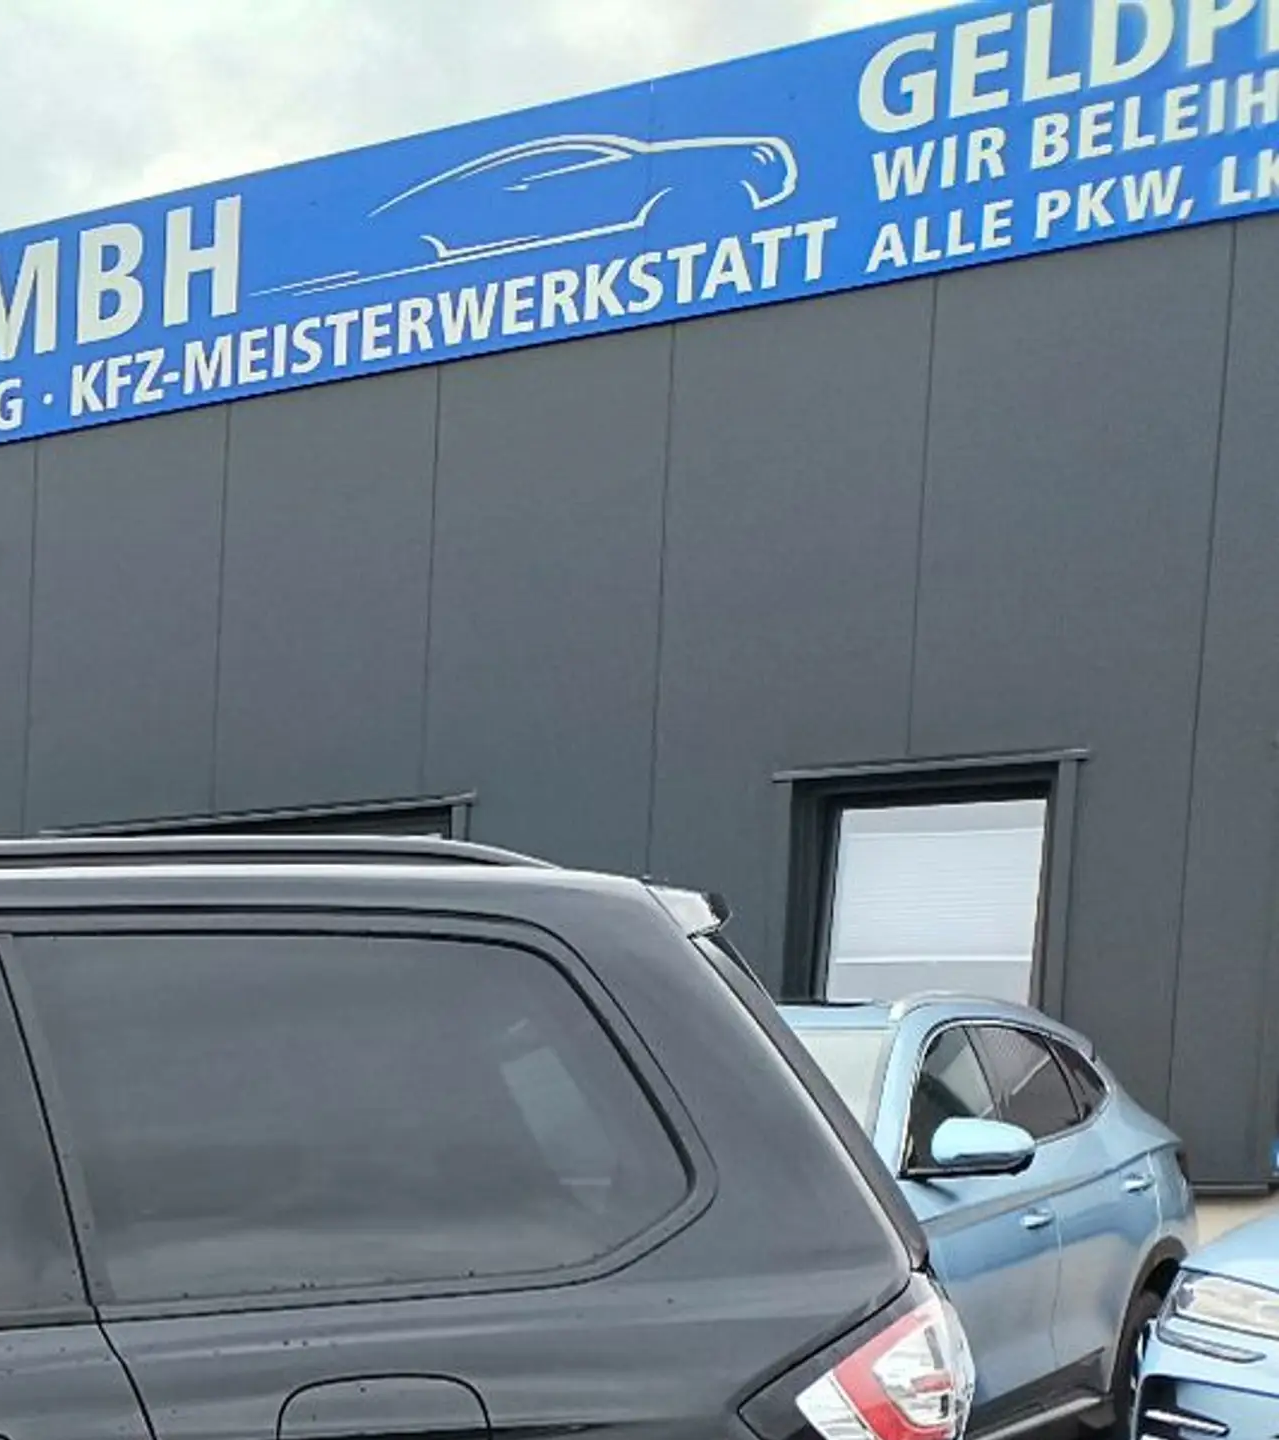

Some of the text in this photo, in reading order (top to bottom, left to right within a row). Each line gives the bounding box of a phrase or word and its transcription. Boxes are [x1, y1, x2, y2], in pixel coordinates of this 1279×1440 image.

[858, 0, 1279, 133] GELDP
[873, 70, 1279, 201] WIR BELEIH
[866, 199, 1013, 273] ALLE
[1035, 166, 1194, 239] PKW,
[70, 217, 837, 416] KFZ-MEISTERWERKSTATT
